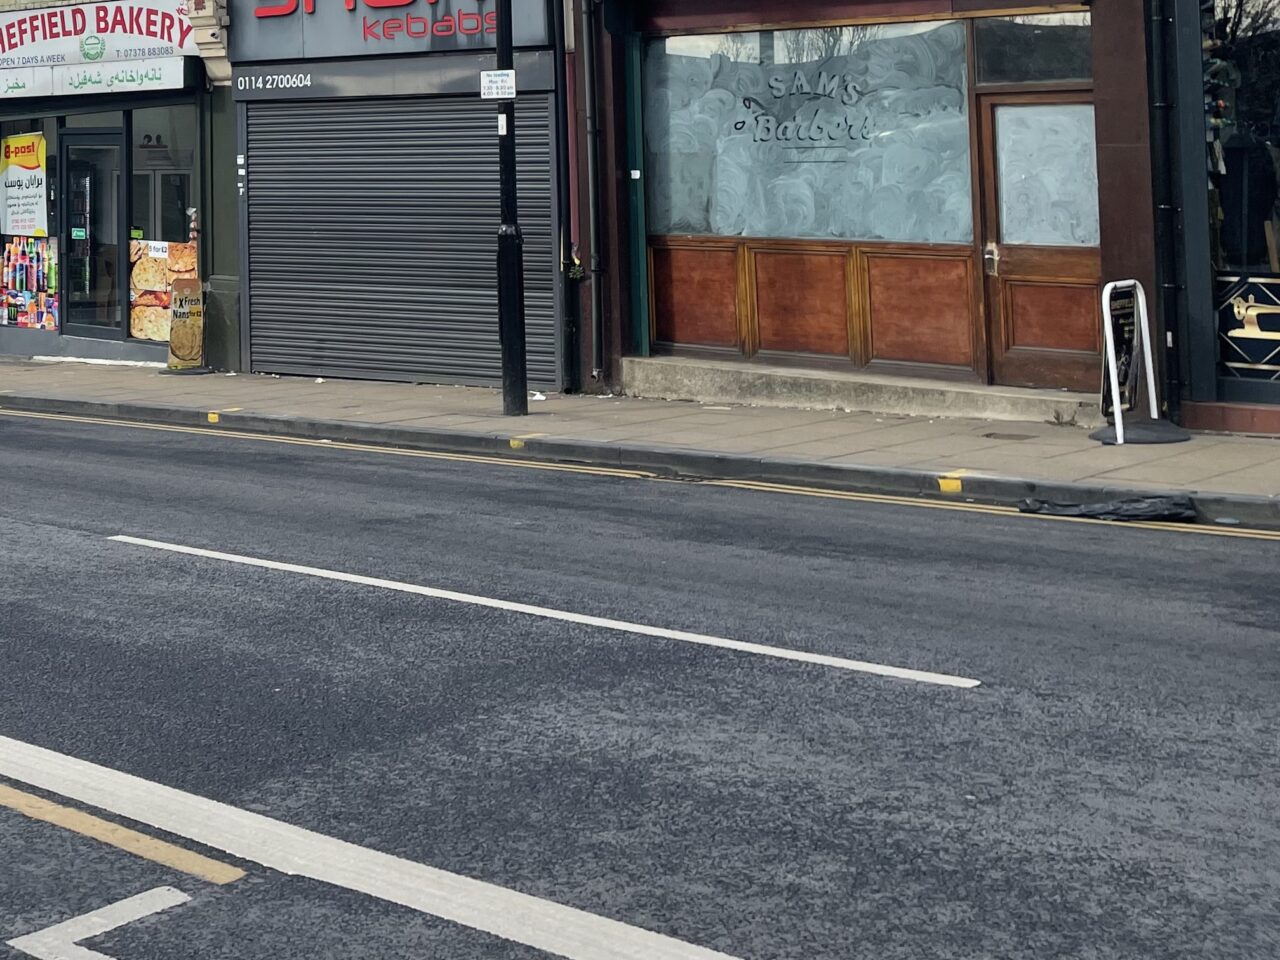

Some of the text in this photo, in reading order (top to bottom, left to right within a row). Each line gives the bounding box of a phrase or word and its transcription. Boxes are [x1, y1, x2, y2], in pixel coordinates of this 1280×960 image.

[95, 6, 193, 49] BAKERY
[362, 8, 497, 41] kebabs
[124, 48, 145, 58] 07378
[17, 57, 21, 65] 7
[22, 56, 39, 65] DAYS
[40, 55, 45, 63] A
[46, 54, 66, 63] WEEK
[237, 73, 311, 90] 0114 2700604
[153, 245, 161, 253] for
[185, 296, 200, 305] Fresh
[173, 309, 189, 319] Nans
